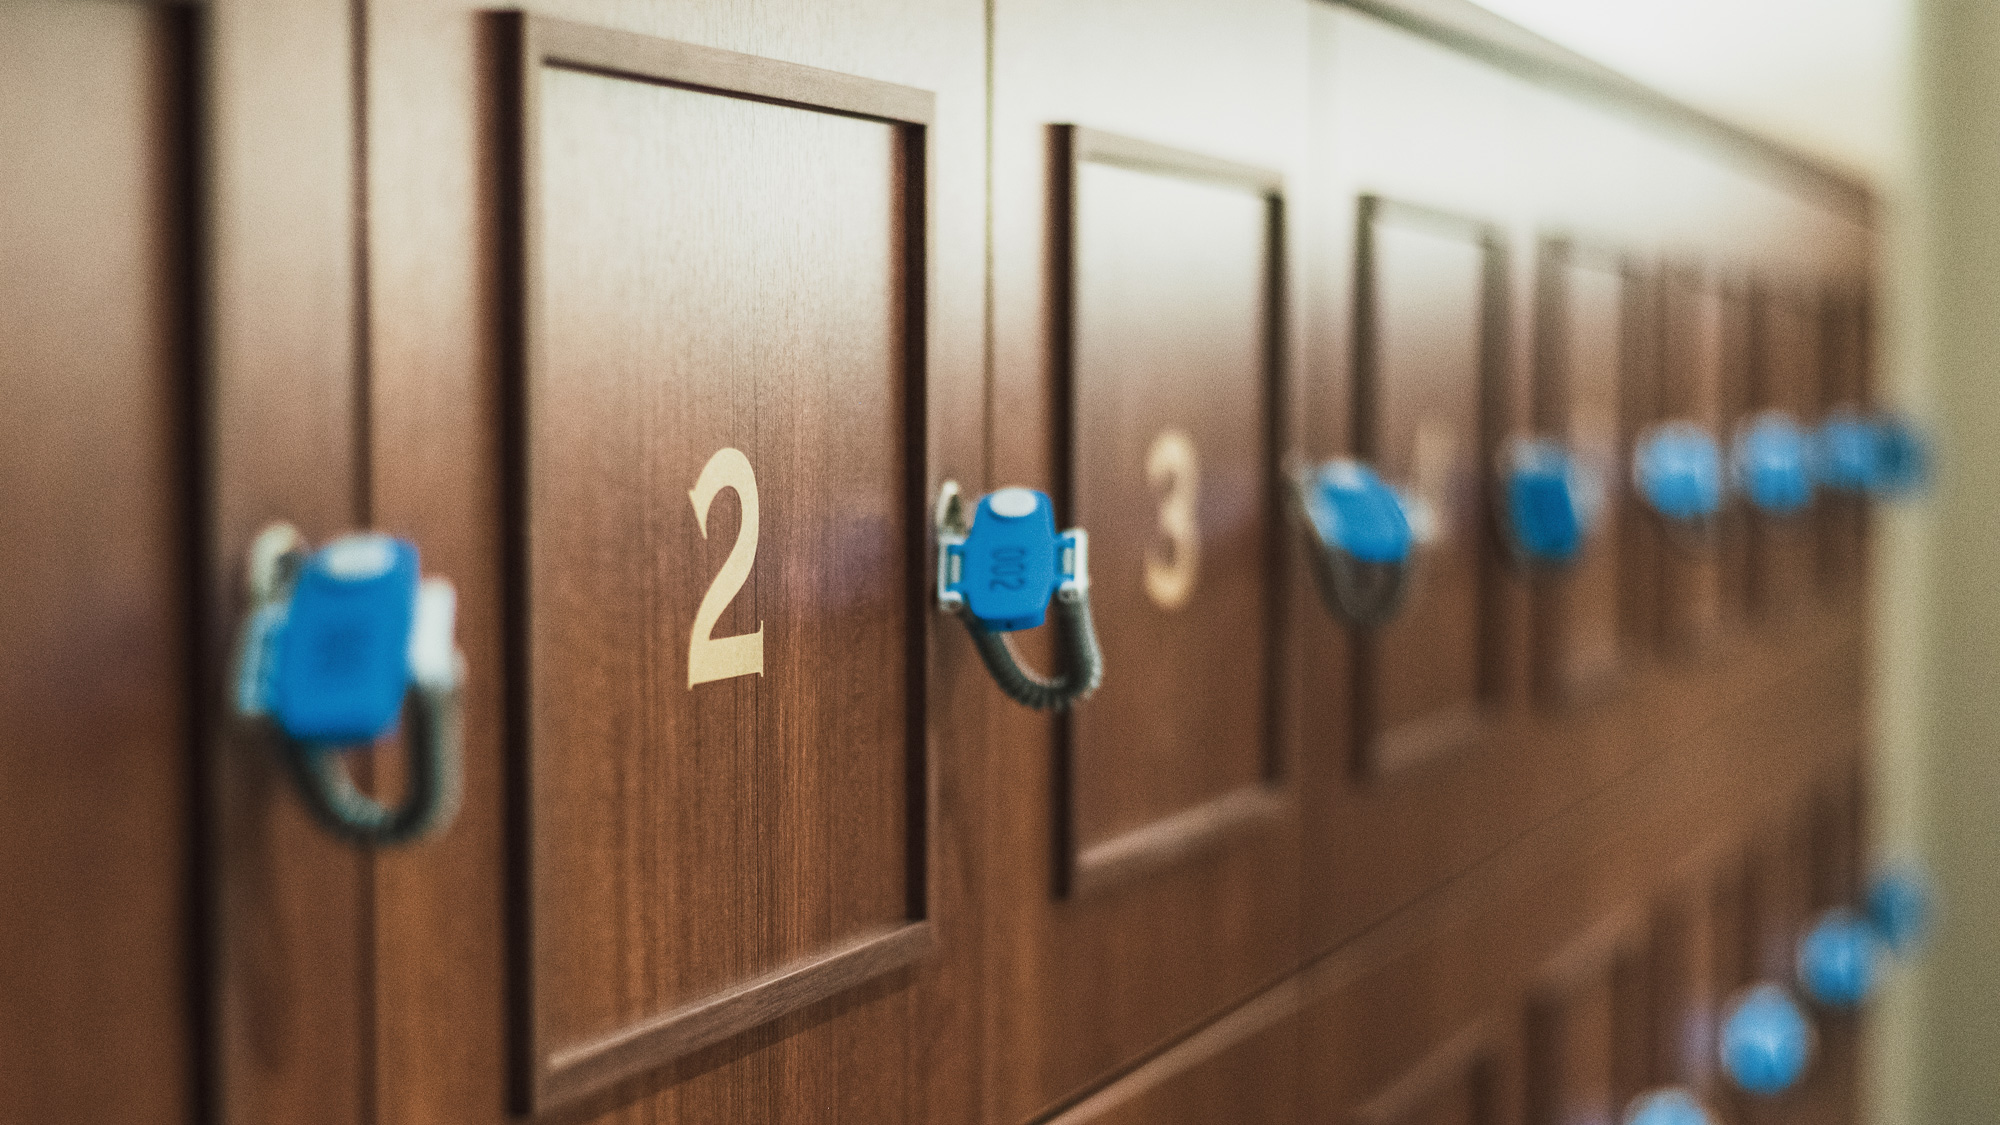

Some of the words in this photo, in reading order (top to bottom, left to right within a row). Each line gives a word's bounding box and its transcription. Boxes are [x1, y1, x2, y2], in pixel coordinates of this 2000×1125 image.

[688, 448, 764, 690] 2
[990, 548, 1026, 592] 002
[1147, 431, 1200, 608] 3
